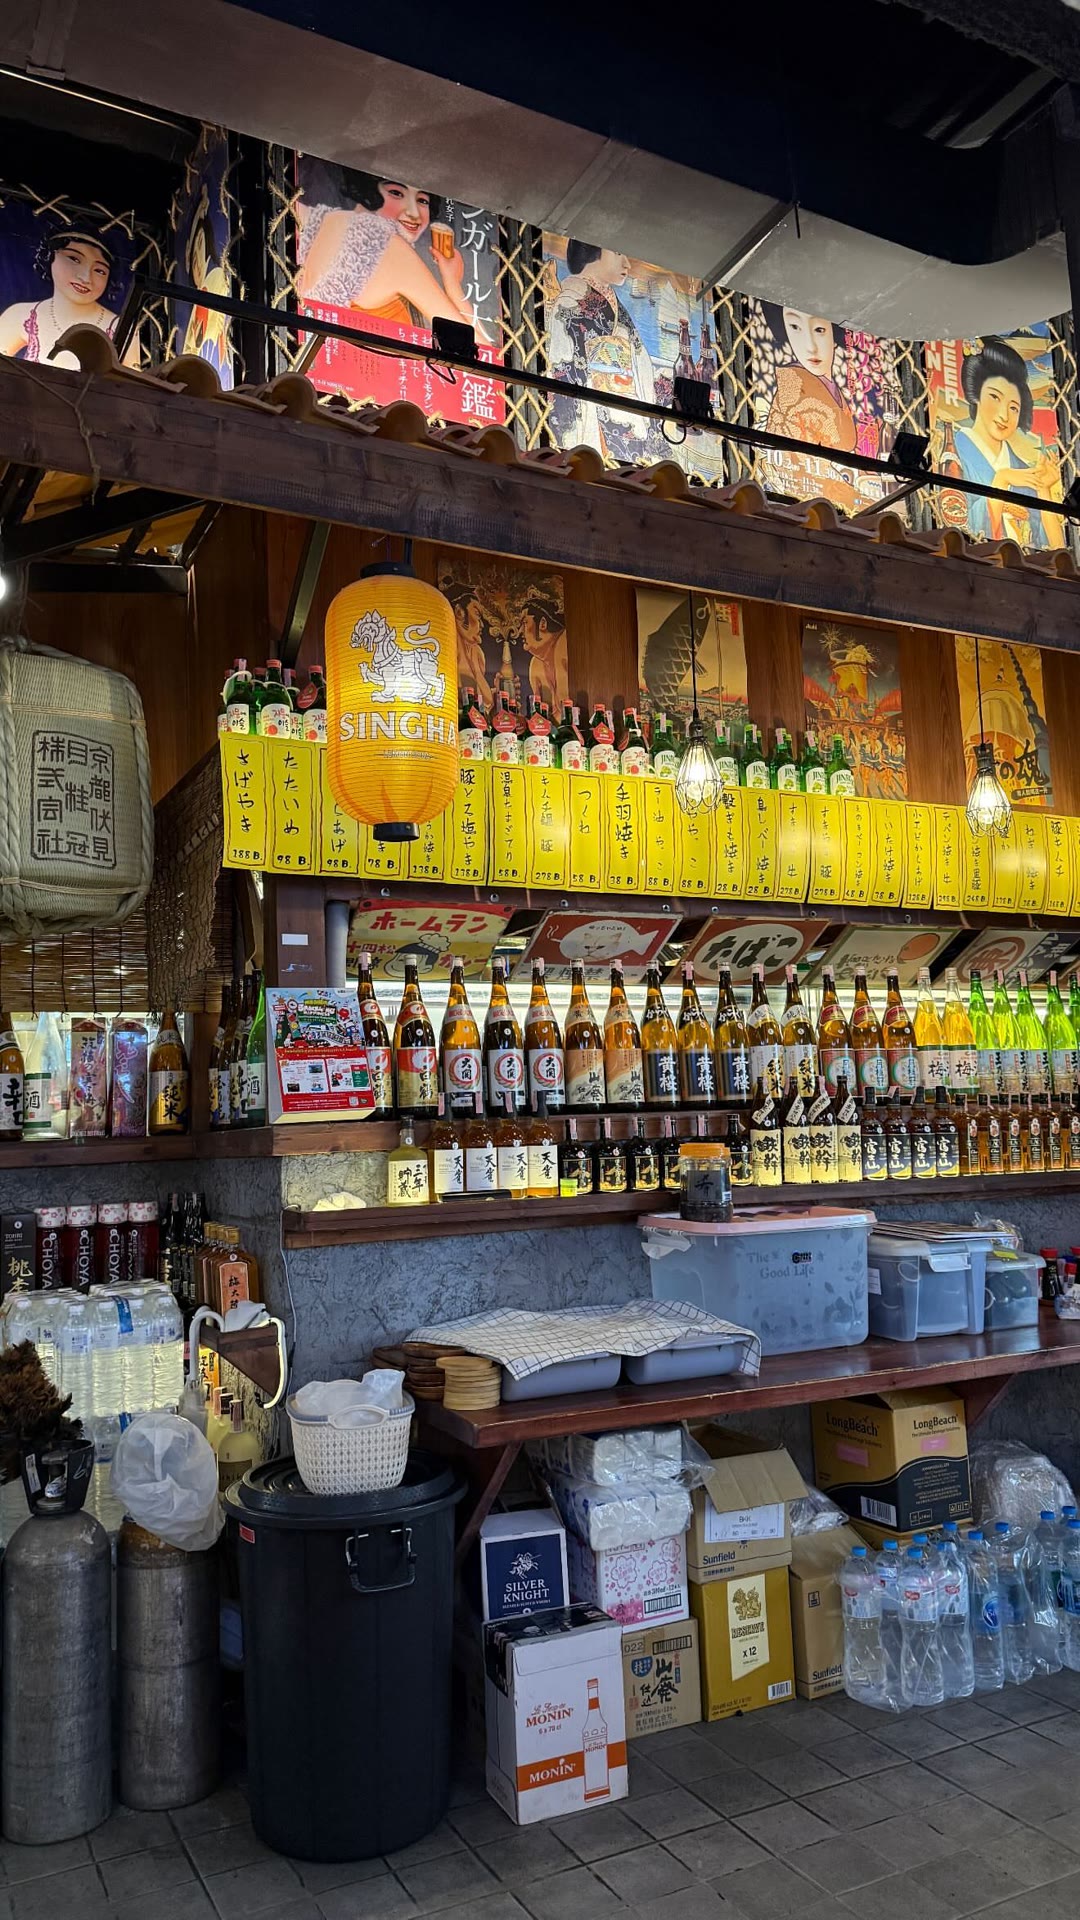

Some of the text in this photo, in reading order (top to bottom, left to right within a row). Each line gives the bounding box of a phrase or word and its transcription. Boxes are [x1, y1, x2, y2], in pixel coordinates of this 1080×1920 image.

[233, 848, 251, 860] 188
[277, 855, 291, 865] 98
[327, 858, 339, 868] 98
[370, 911, 489, 934] ホームラン
[703, 932, 799, 970] たばこ
[79, 1232, 90, 1287] CHOYA
[760, 1264, 815, 1279] Good Life
[825, 1411, 880, 1437] LongBeach
[913, 1414, 959, 1431] LongBeach
[703, 1550, 736, 1565] Sunfield
[505, 1578, 546, 1593] SILVER
[503, 1588, 550, 1604] KNIGHT
[749, 1646, 758, 1657] 12
[812, 1664, 843, 1681] Sunfield
[526, 1707, 573, 1728] MONIN
[529, 1757, 574, 1784] MONIN
